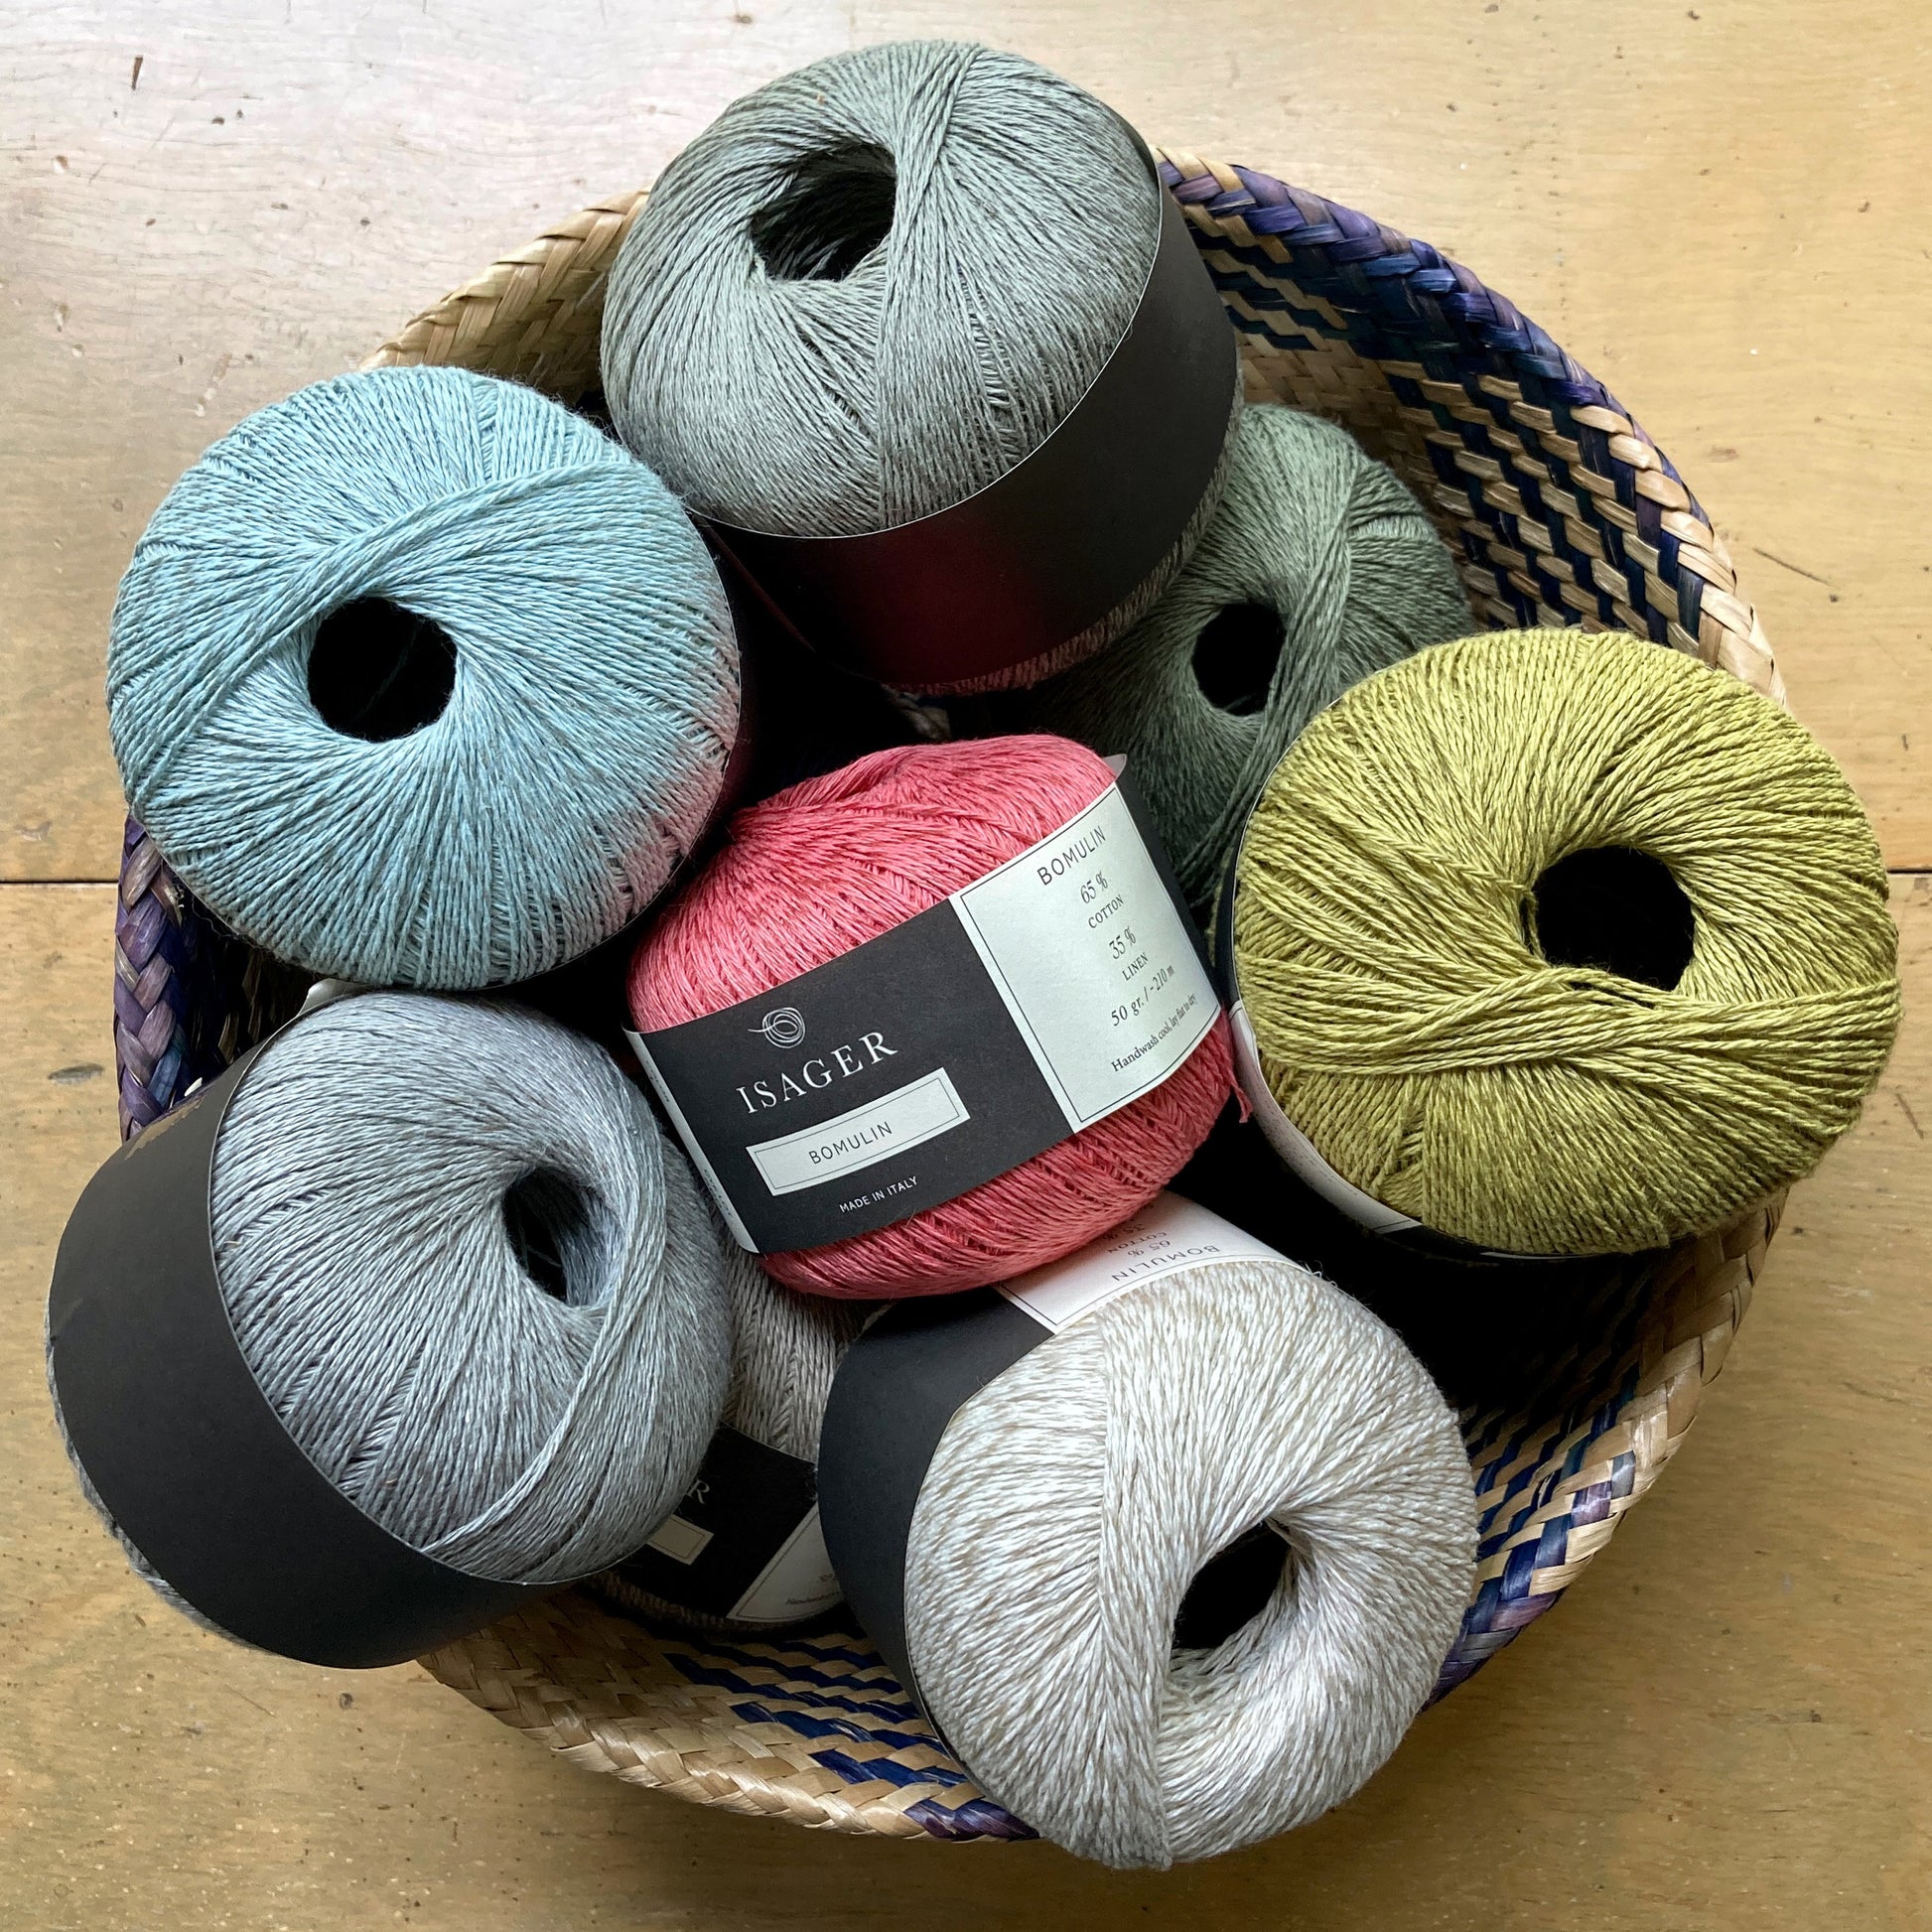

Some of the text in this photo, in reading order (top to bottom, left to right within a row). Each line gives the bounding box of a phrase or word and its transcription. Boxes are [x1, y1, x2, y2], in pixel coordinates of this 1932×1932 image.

[1036, 826, 1106, 886] BOMULIN
[1080, 871, 1109, 904] 65 %
[1088, 894, 1124, 929] COTTON
[1109, 926, 1136, 960] 35 %
[1122, 952, 1149, 981] LINEN
[1111, 1005, 1128, 1027] 50
[1131, 997, 1145, 1017] gr.
[1167, 965, 1175, 977] m
[1110, 1035, 1159, 1072] Handwash
[1158, 1022, 1173, 1040] cool,
[1169, 1013, 1180, 1028] lay
[736, 1031, 898, 1114] ISAGER
[808, 1122, 893, 1165] BOMULIN
[839, 1175, 918, 1213] MADE IN ITALY
[1107, 1232, 1167, 1253] COTTON
[1127, 1240, 1171, 1258] 65 %
[1111, 1245, 1220, 1281] BOMULIN
